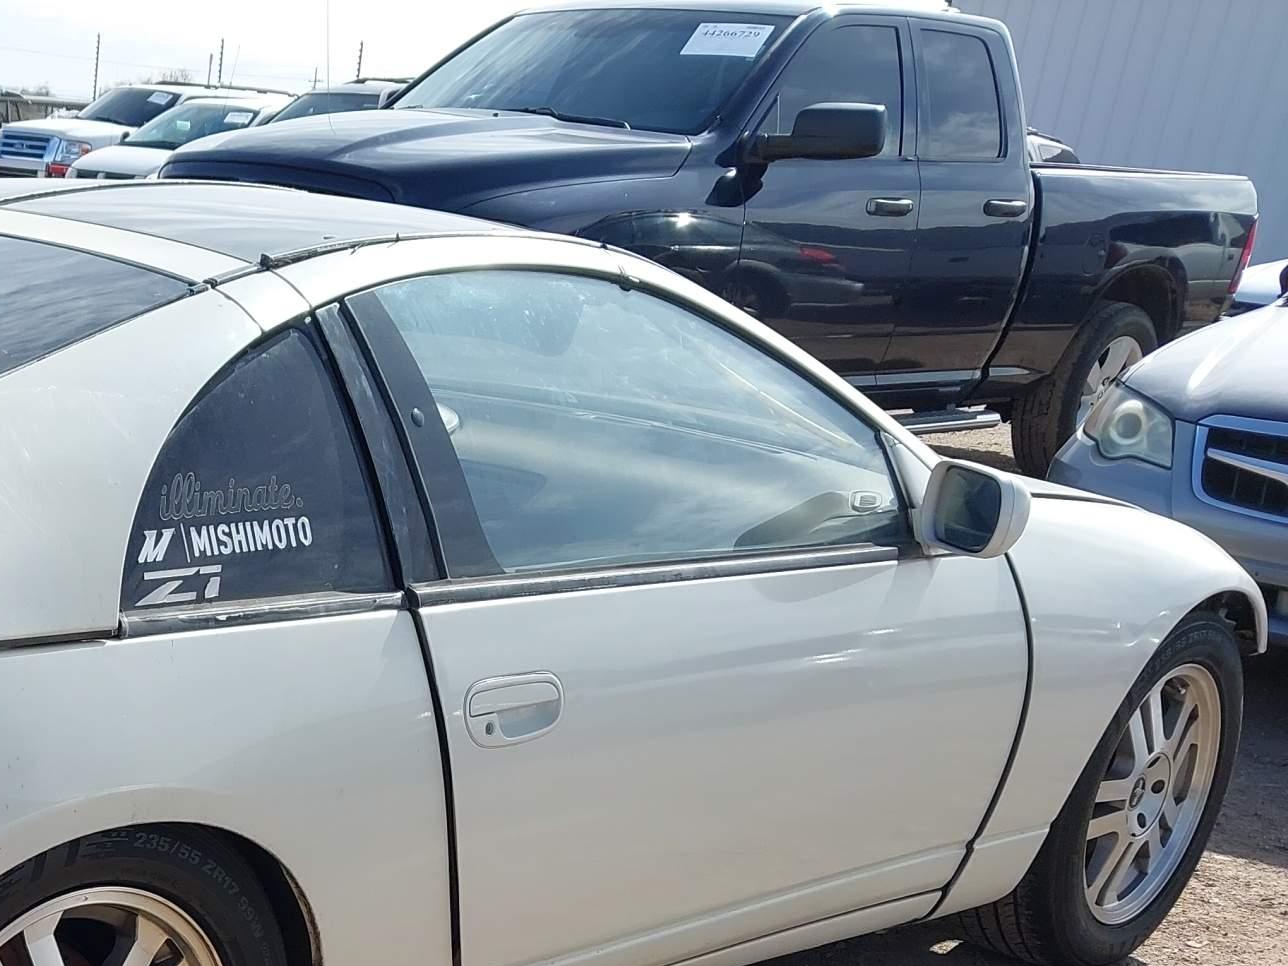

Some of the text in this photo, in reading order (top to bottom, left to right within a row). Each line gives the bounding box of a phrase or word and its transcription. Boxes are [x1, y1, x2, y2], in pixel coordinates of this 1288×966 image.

[138, 516, 313, 563] M MISHIMOTO
[133, 832, 201, 865] 235/55
[201, 859, 240, 895] ZR17
